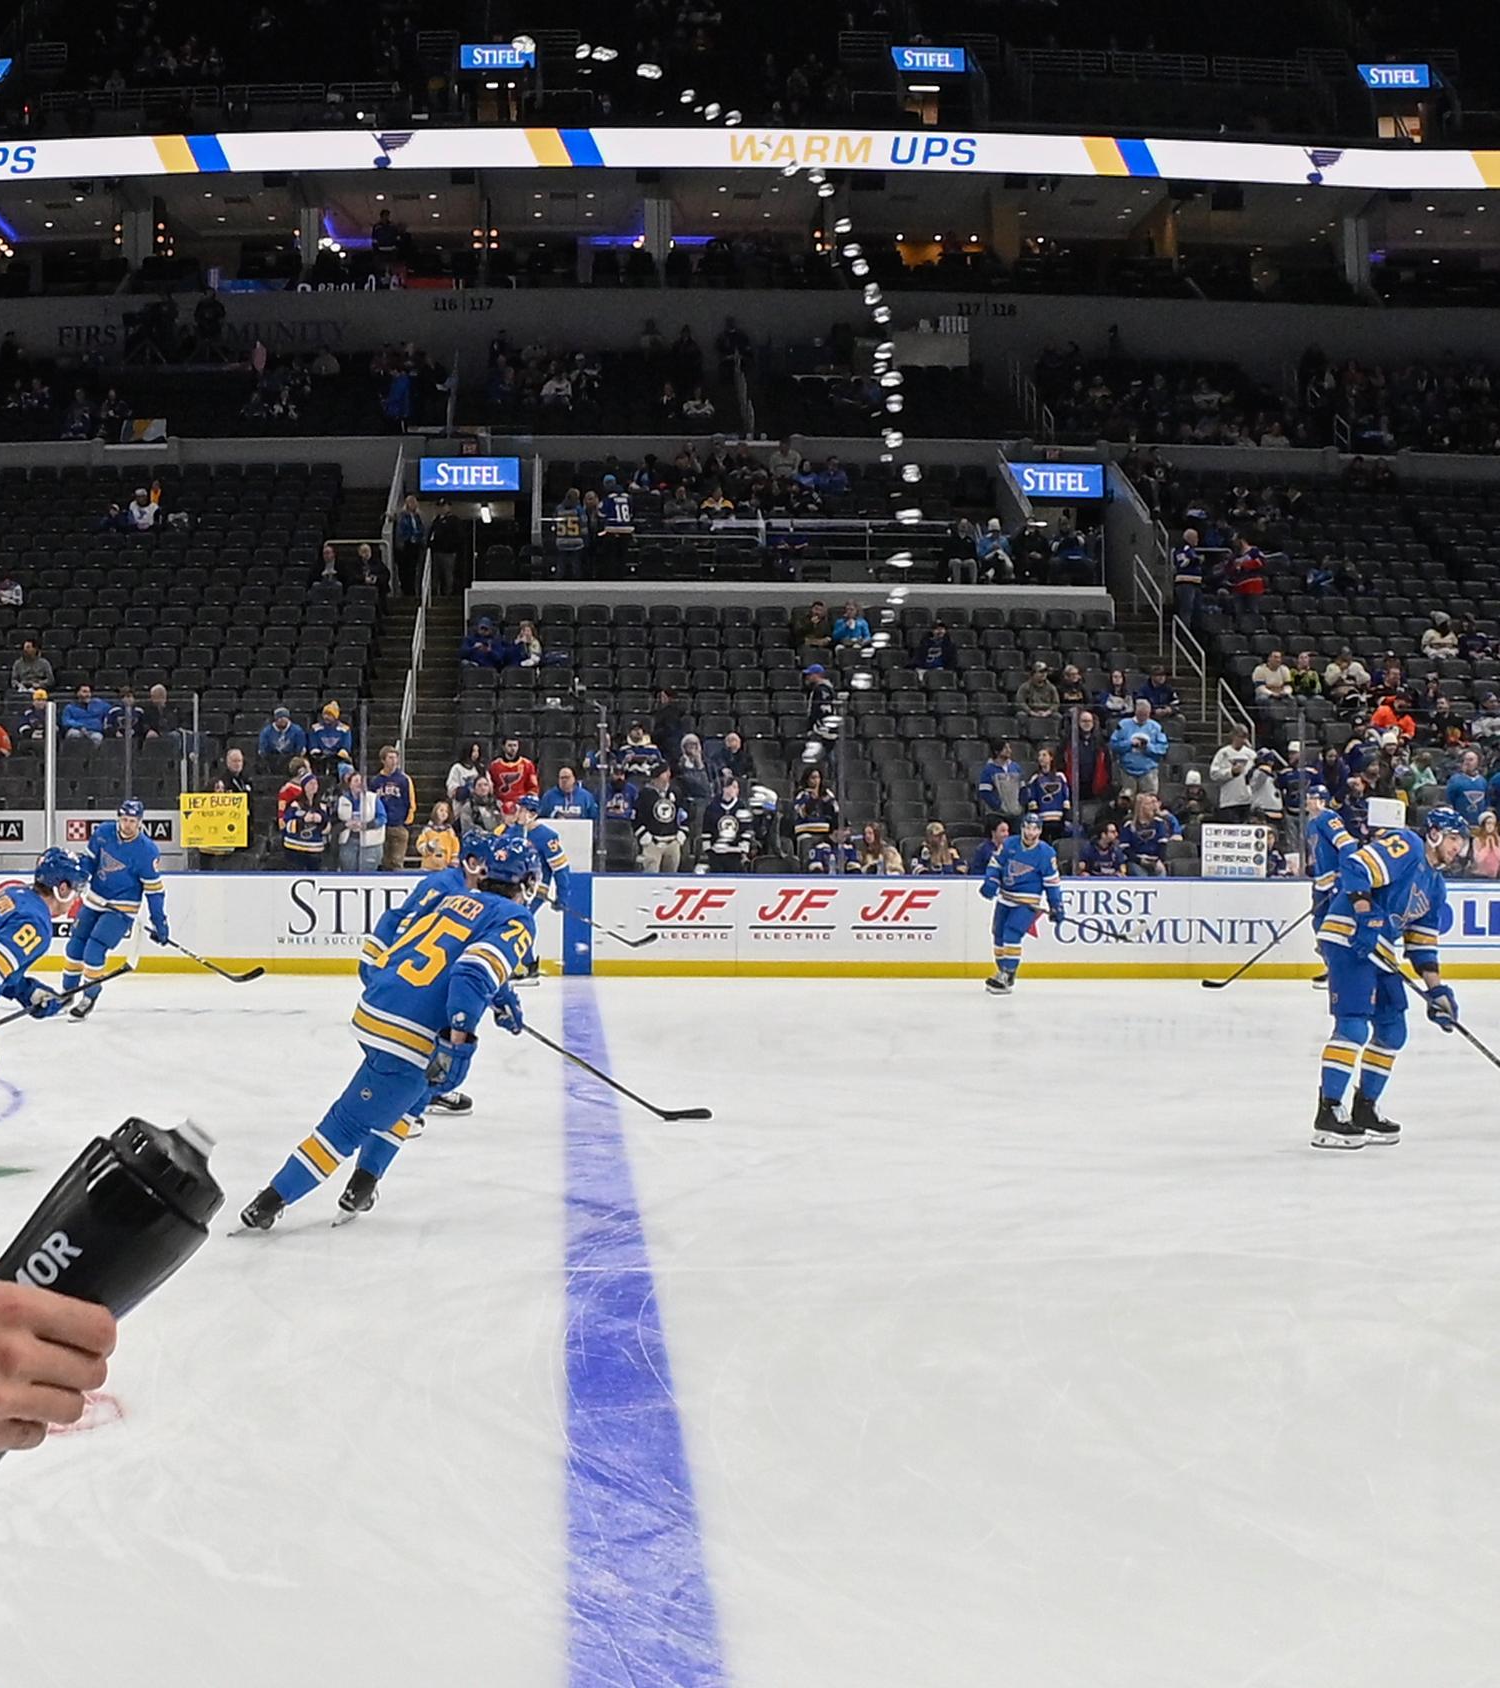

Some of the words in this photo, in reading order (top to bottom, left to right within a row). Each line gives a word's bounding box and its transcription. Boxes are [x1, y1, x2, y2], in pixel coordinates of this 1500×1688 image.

[474, 48, 524, 64] STIFEL
[904, 50, 954, 67] STIFEL
[1370, 68, 1419, 84] STIFEL
[729, 134, 873, 163] WARM
[891, 136, 977, 166] UPS
[58, 326, 120, 346] FIRS
[437, 463, 504, 486] STIFEL
[1023, 468, 1090, 492] STIFEL
[288, 879, 409, 935] STIF
[1062, 889, 1158, 916] FIRST
[11, 923, 44, 956] 81
[500, 918, 533, 960] 75
[661, 932, 729, 940] LECTRIC
[754, 932, 832, 941] ELECTRIC
[853, 932, 934, 941] ELECTRIC
[1053, 918, 1288, 945] COMMUNITY
